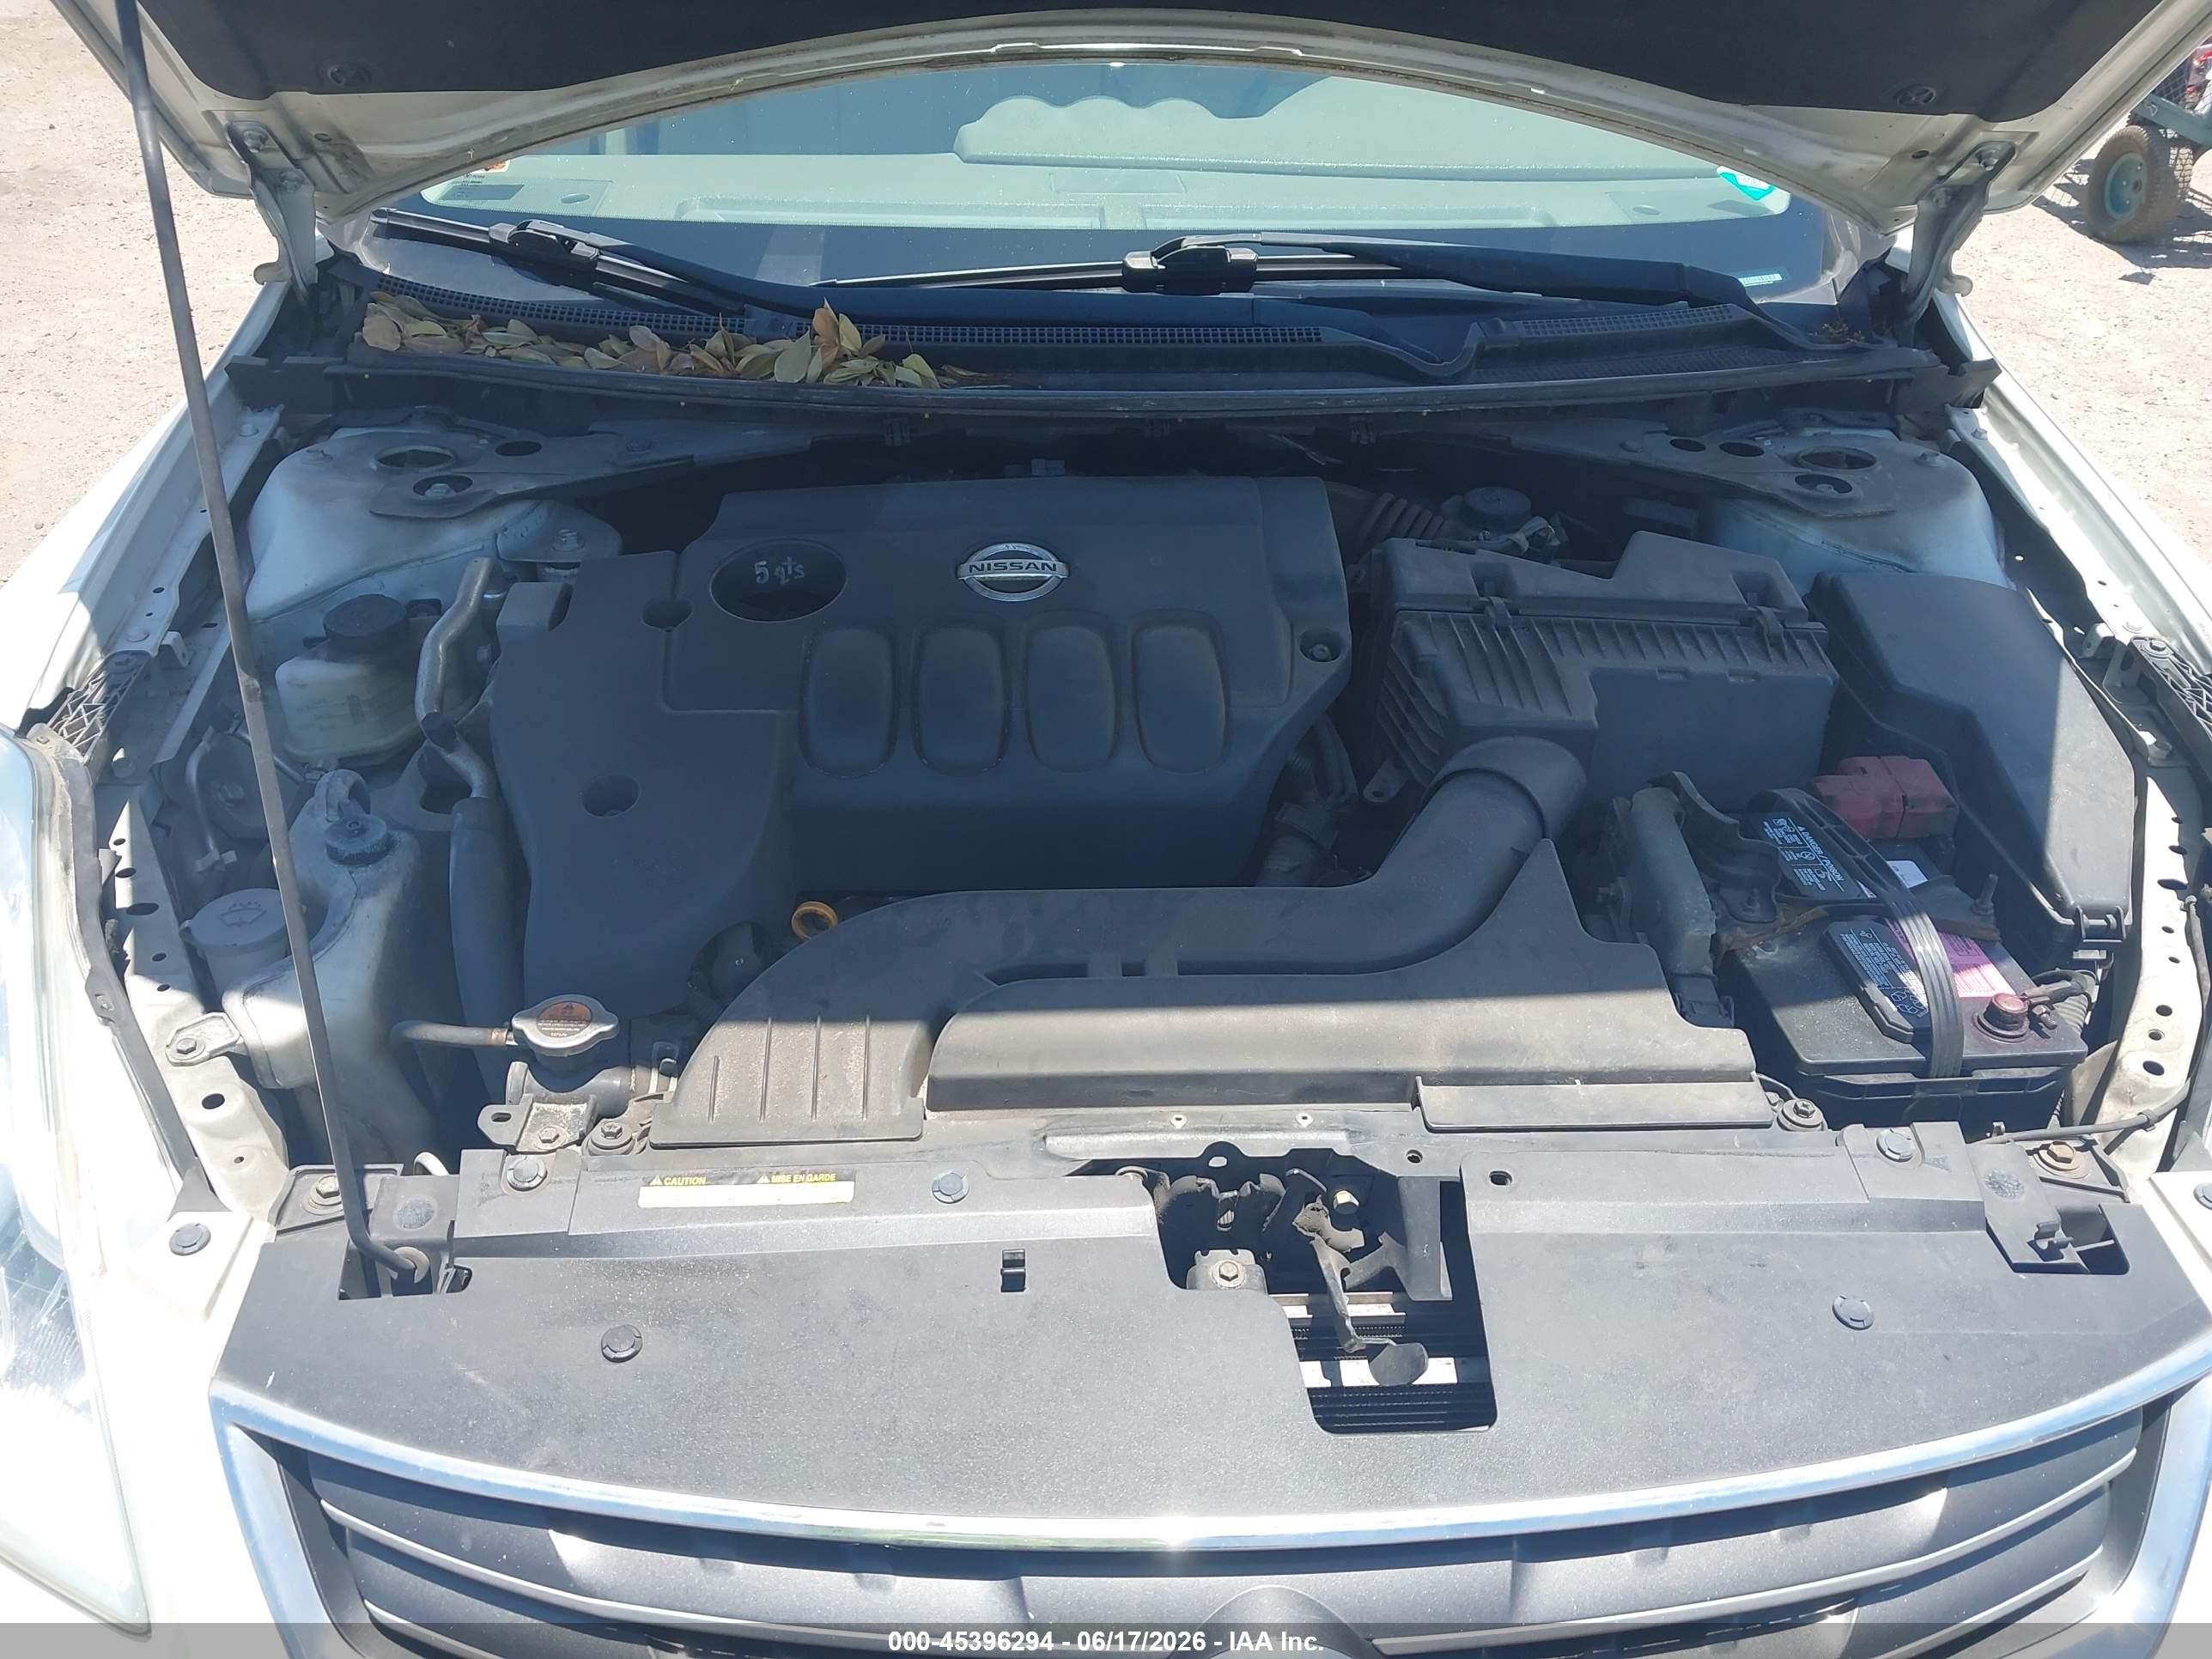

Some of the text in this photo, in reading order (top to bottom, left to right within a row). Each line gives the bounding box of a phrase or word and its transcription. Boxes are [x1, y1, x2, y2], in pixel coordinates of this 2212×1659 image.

[755, 556, 805, 585] 5 qts
[969, 562, 1057, 574] NISSAN
[1802, 831, 1823, 854] DANGER
[1821, 859, 1845, 881] POISON
[663, 1176, 707, 1186] CAUTION
[771, 1173, 836, 1183] MISE EN GARDE
